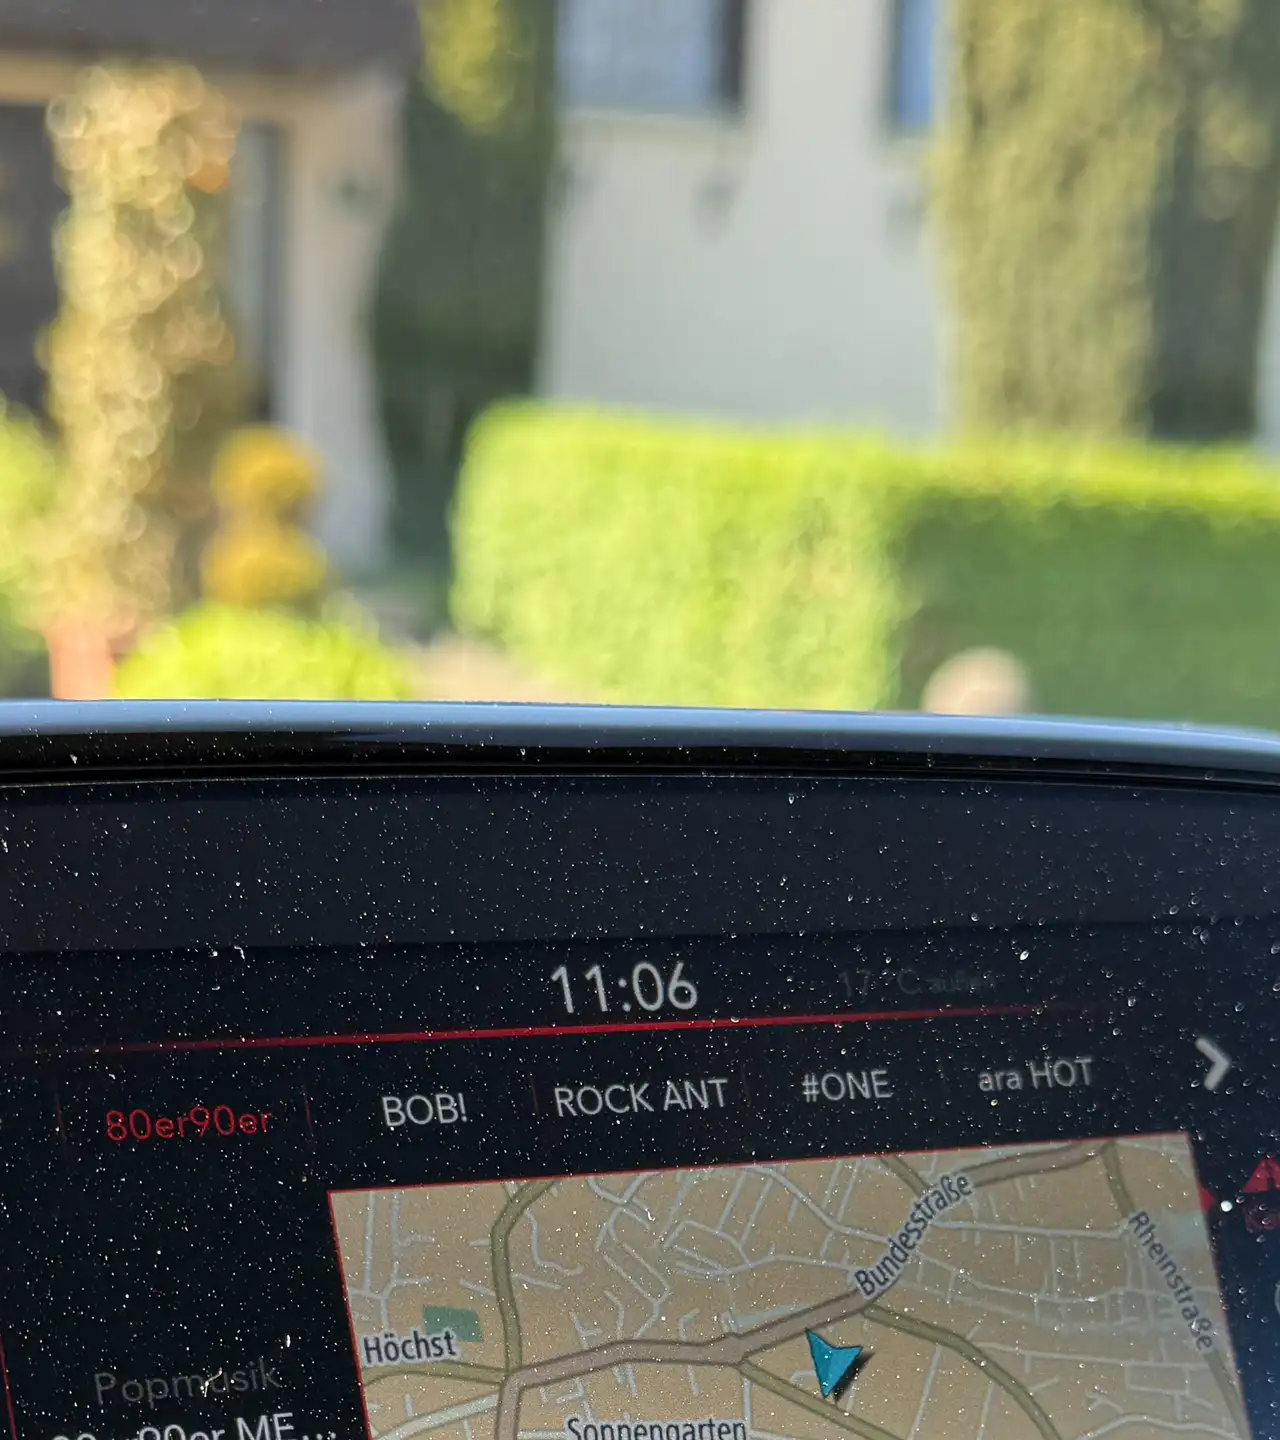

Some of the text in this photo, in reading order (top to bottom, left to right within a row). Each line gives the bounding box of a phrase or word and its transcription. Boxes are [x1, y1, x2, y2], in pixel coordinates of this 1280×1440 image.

[550, 961, 699, 1013] 11:06
[801, 1068, 894, 1103] #ONE
[978, 1056, 1094, 1092] ara HOT
[382, 1093, 468, 1127] BOB!
[553, 1077, 729, 1117] ROCK ANT
[105, 1105, 269, 1142] 80er90er
[854, 1176, 972, 1295] Bundesstraße
[1128, 1211, 1213, 1350] Rheinstraße
[363, 1330, 457, 1364] Höchst
[94, 1358, 282, 1408] Popmusik
